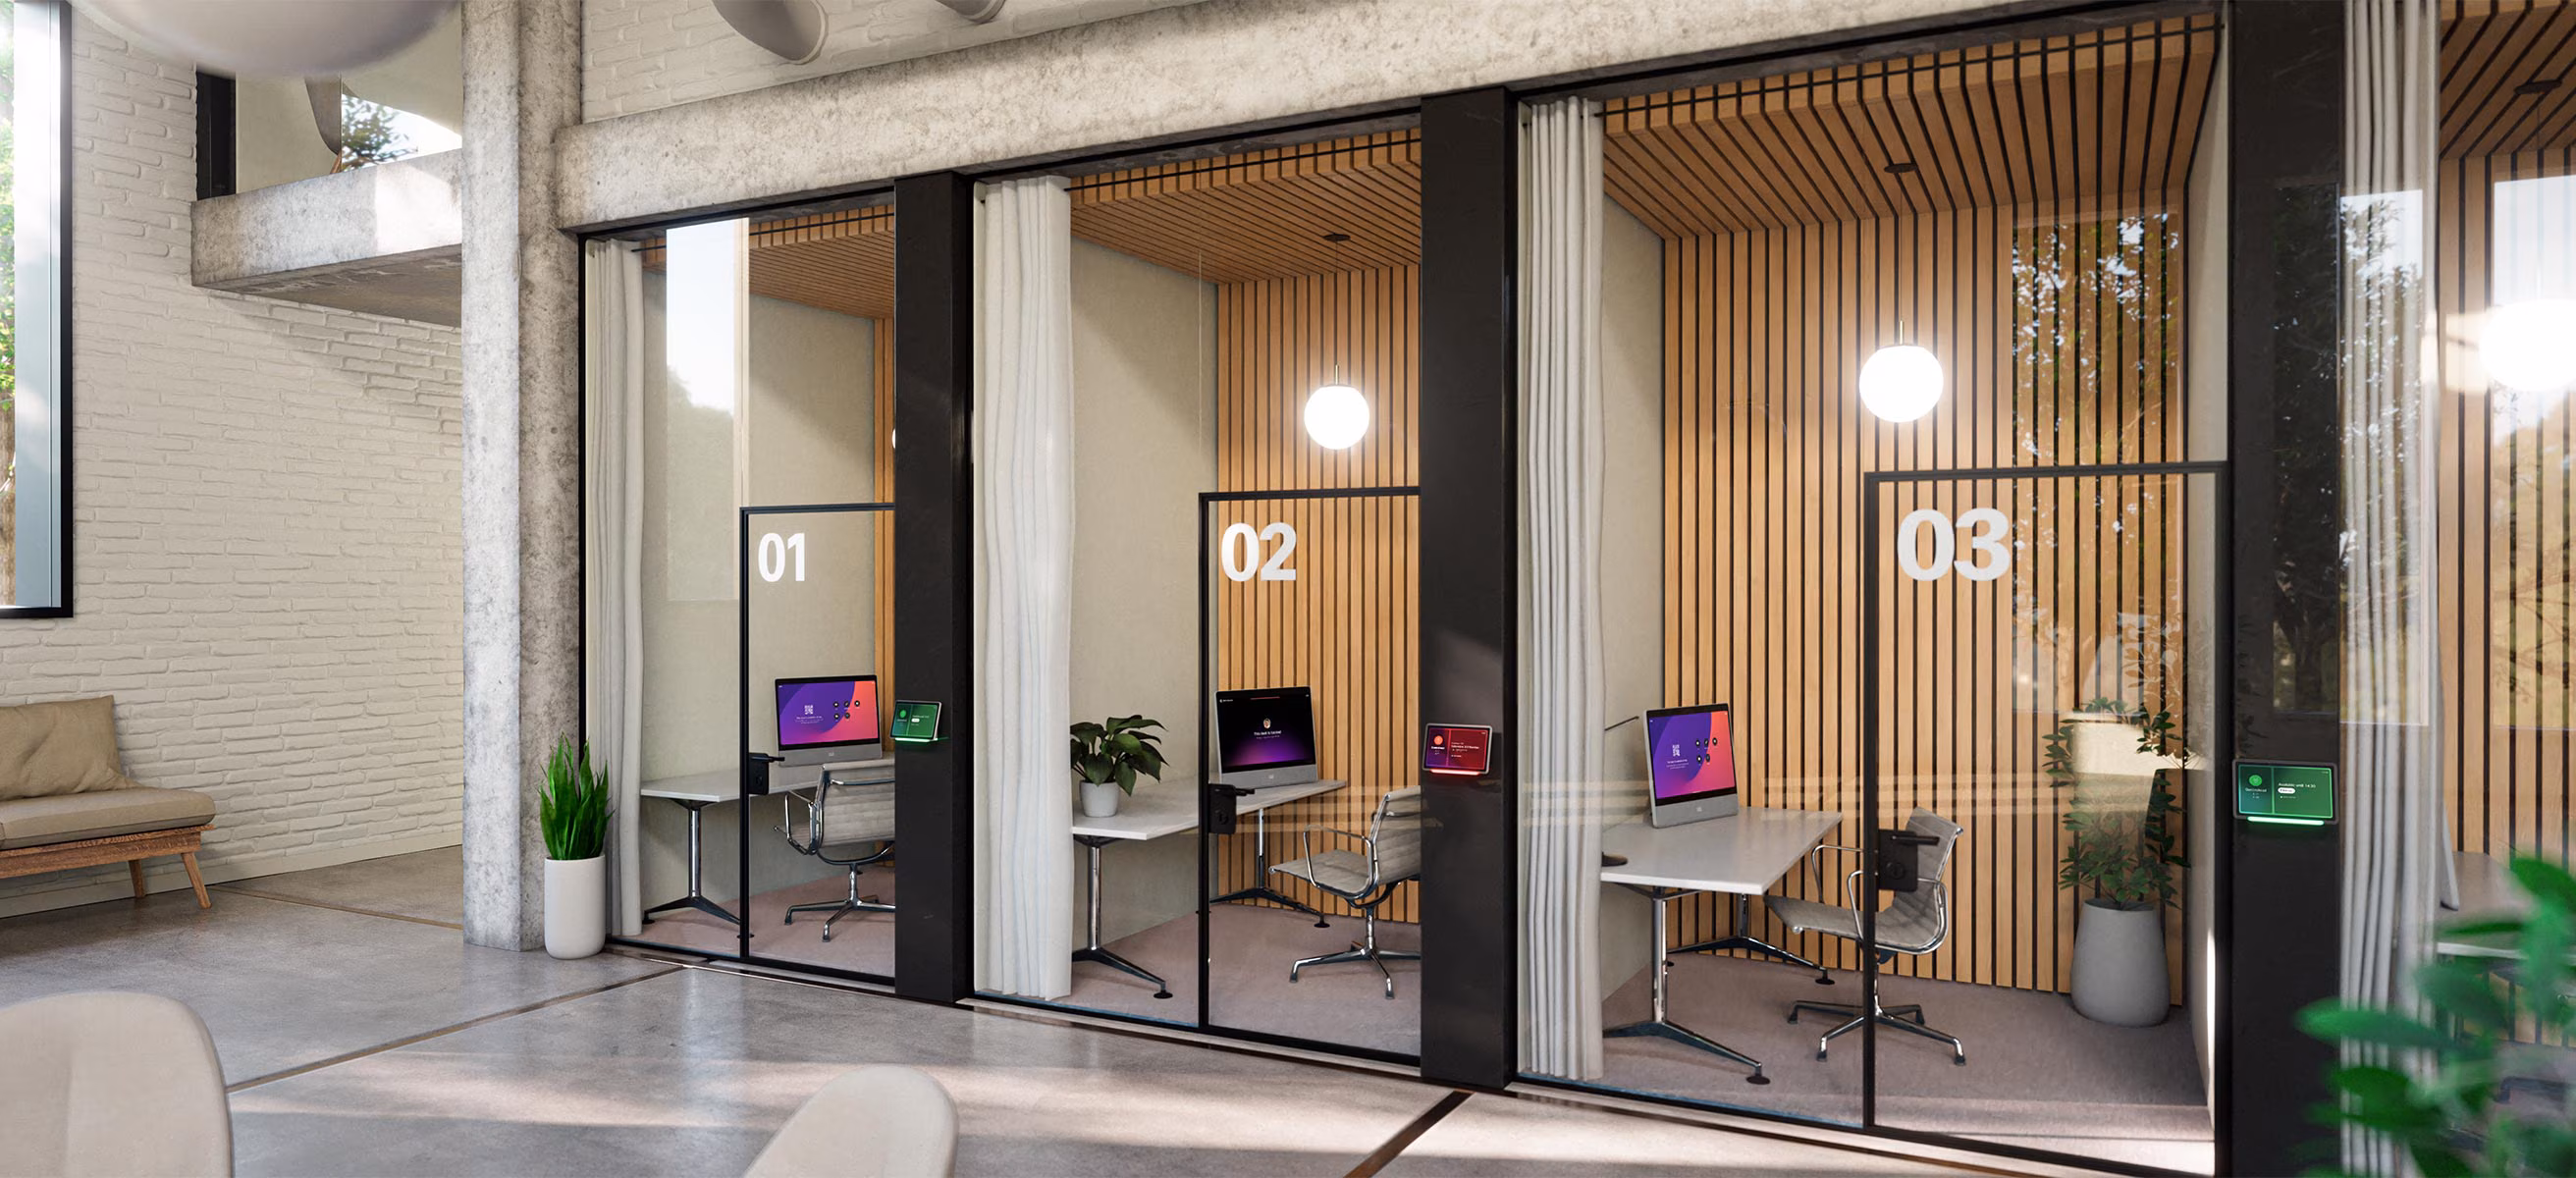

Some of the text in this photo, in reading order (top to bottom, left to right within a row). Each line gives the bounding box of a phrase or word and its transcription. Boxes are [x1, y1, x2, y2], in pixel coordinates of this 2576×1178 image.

[758, 532, 805, 582] 01
[1221, 522, 1297, 581] 02
[1897, 508, 2012, 582] 03
